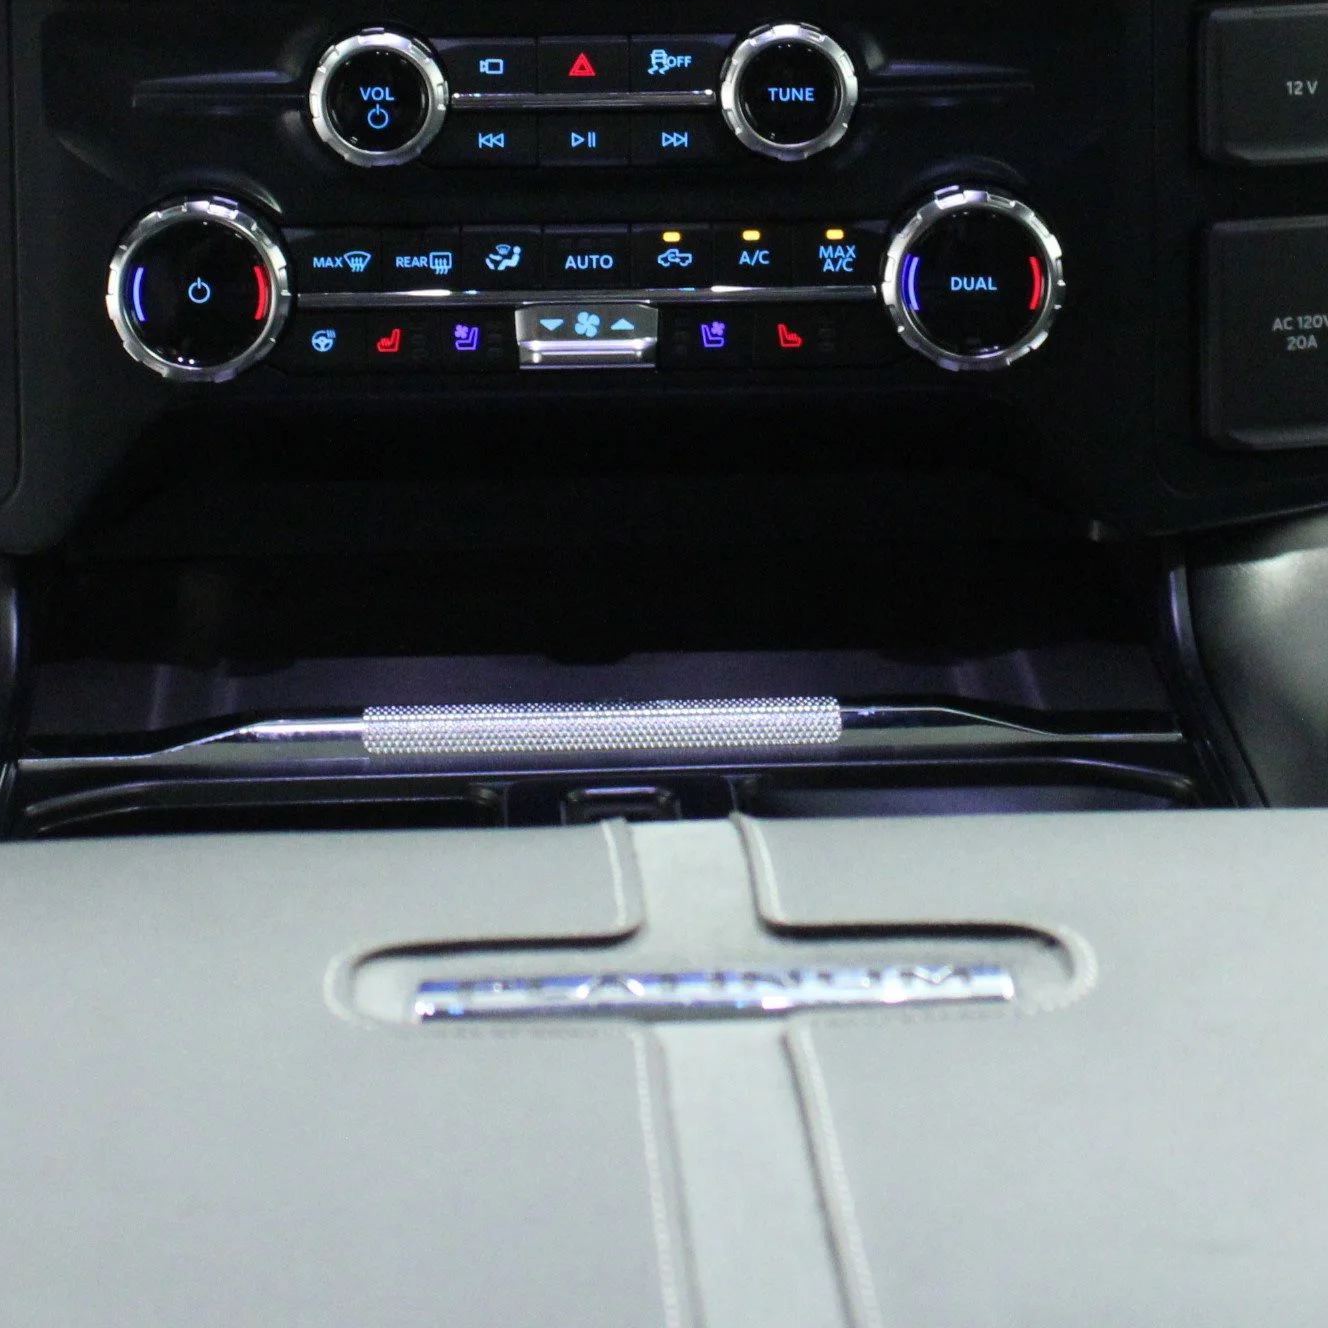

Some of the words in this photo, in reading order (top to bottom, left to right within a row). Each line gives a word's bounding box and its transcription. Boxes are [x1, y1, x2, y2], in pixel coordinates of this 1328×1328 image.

[668, 55, 692, 69] OFF
[360, 87, 394, 101] VOL
[768, 88, 814, 101] TUNE
[1285, 81, 1303, 96] 12
[1305, 80, 1318, 95] V
[739, 250, 769, 265] A/C
[819, 245, 856, 259] MAX
[312, 256, 343, 268] MAX
[395, 256, 428, 268] REAR
[565, 255, 613, 269] AUTO
[822, 259, 854, 272] A/C
[951, 277, 997, 290] DUAL
[1273, 316, 1293, 332] AC
[1287, 335, 1318, 351] 20A
